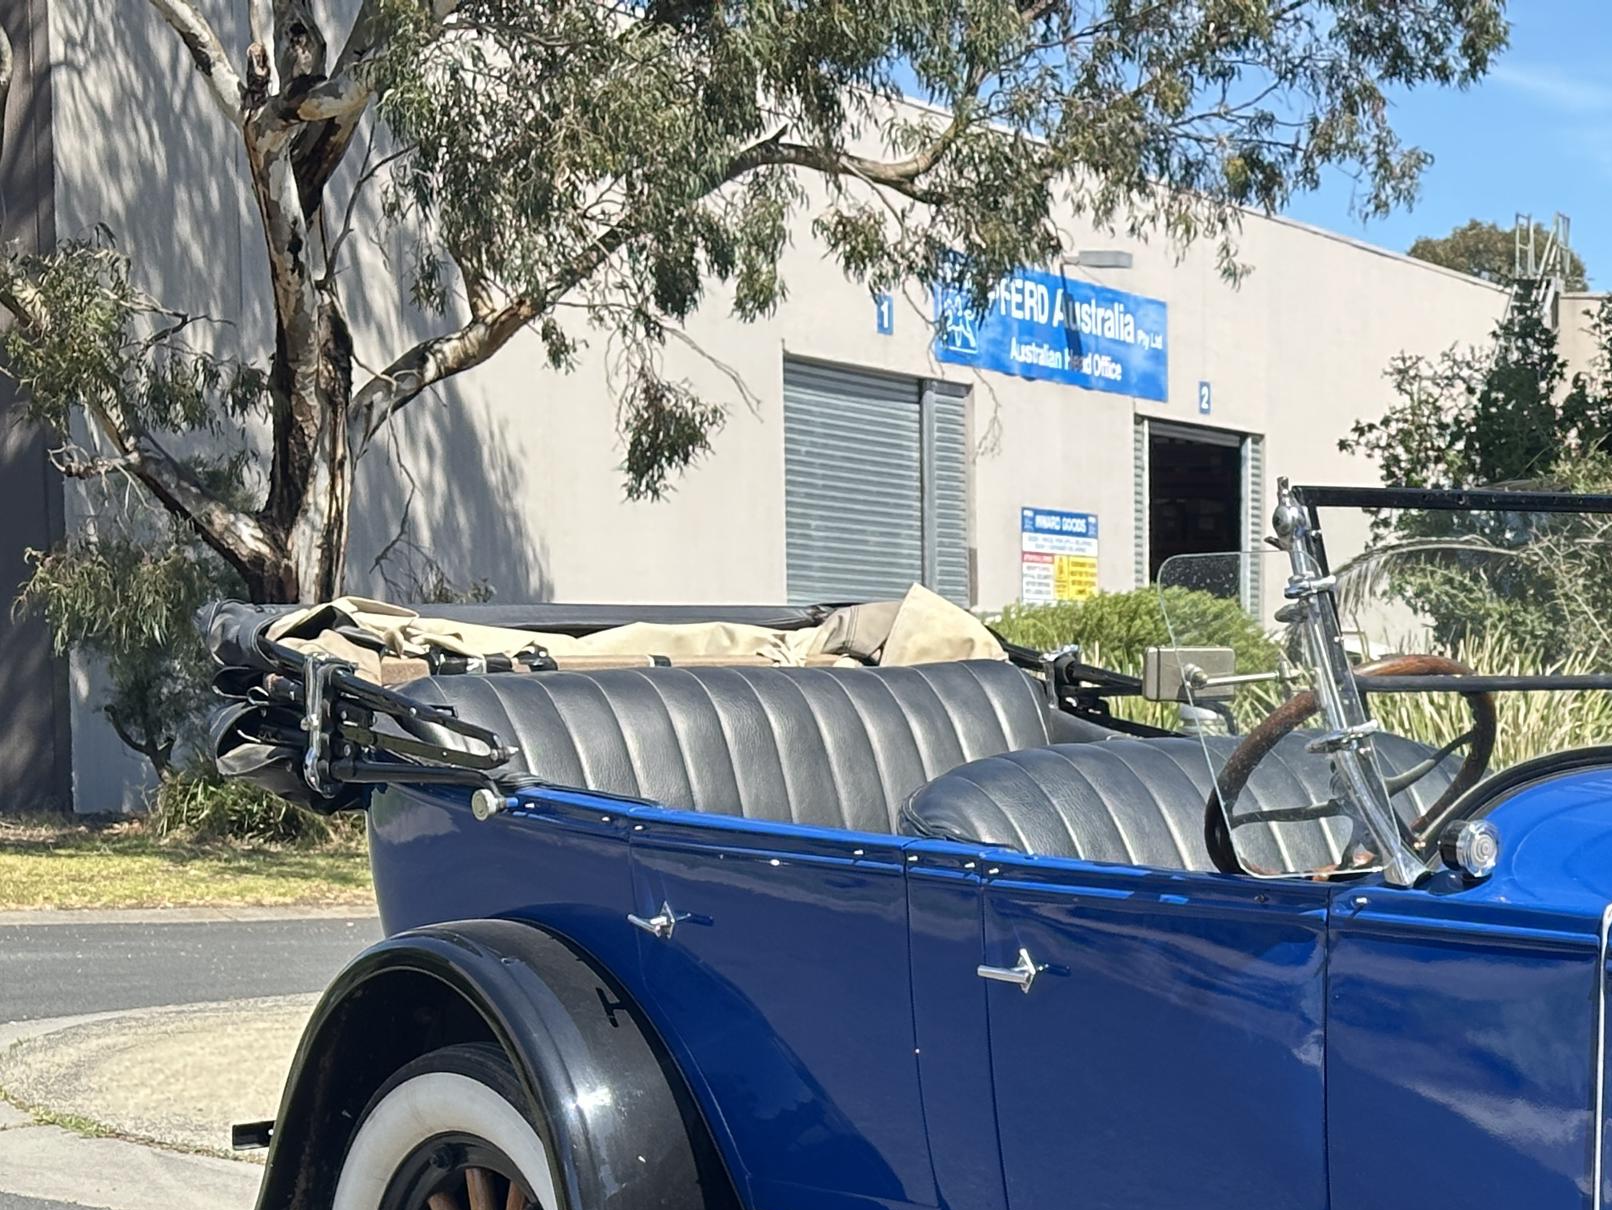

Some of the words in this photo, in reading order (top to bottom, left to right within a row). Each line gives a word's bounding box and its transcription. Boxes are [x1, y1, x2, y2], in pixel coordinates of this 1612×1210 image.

[880, 301, 889, 328] 1
[1052, 288, 1135, 344] Australia
[1010, 336, 1062, 369] Australian
[1064, 347, 1093, 375] Head
[1093, 354, 1122, 381] Office
[1201, 386, 1209, 410] 2
